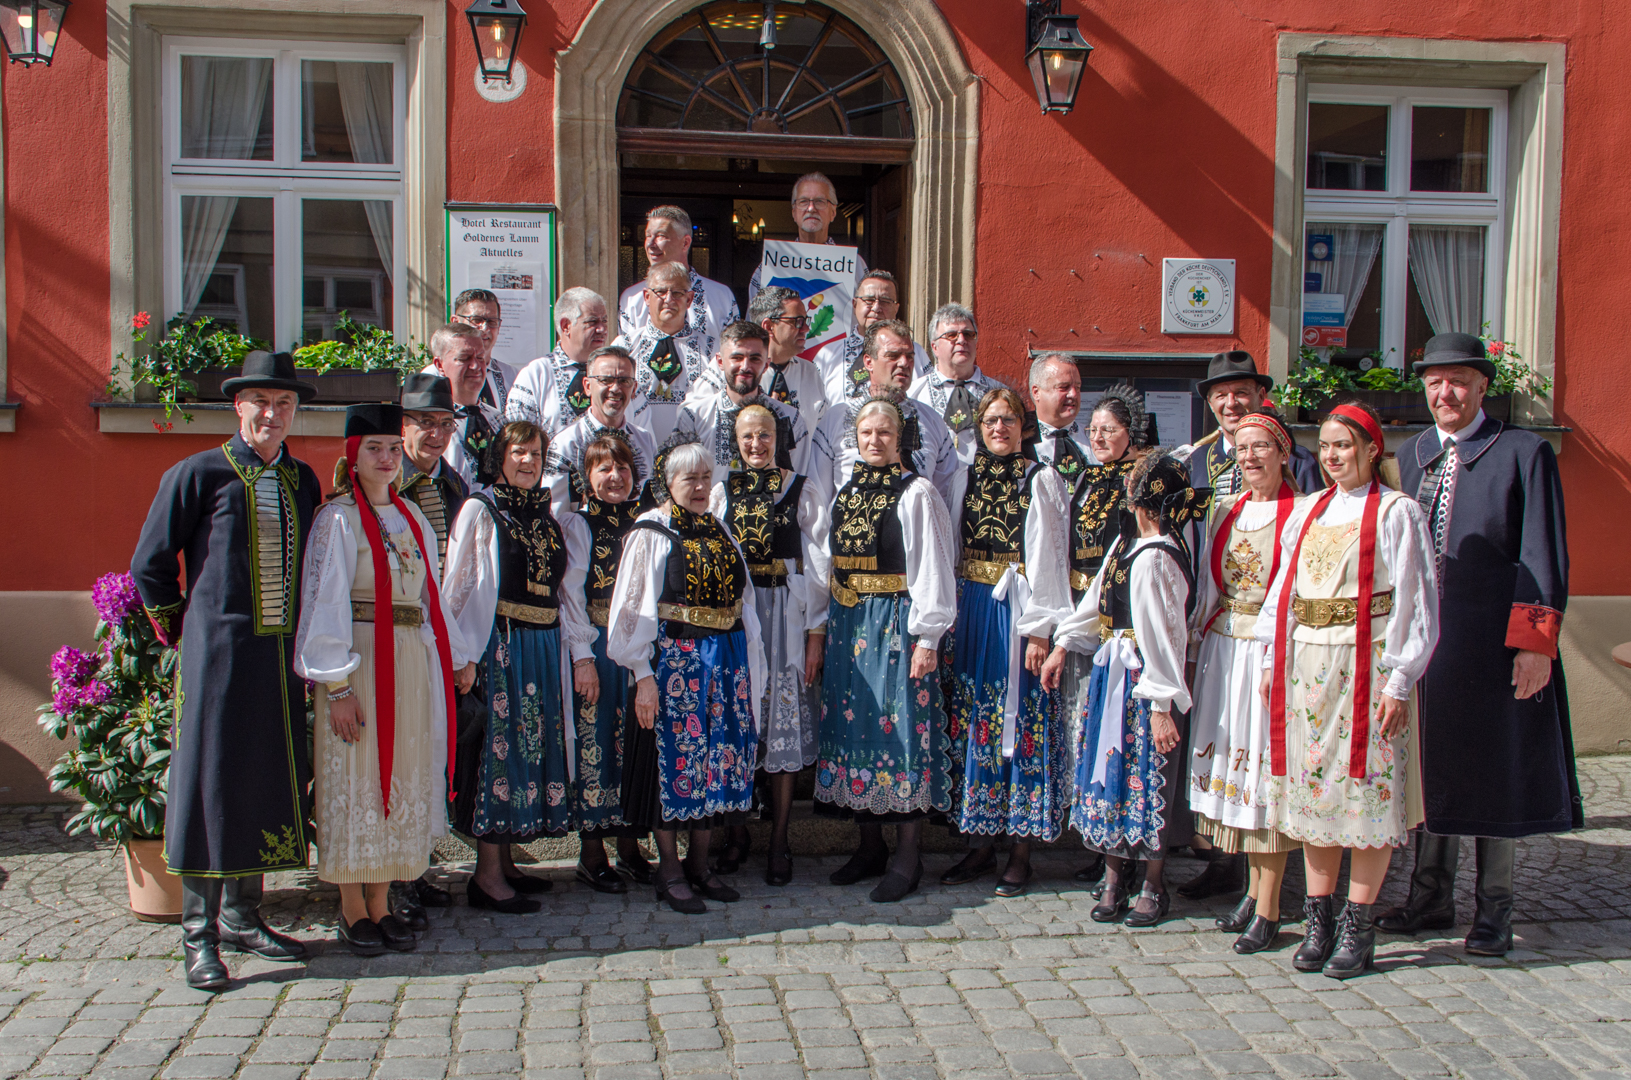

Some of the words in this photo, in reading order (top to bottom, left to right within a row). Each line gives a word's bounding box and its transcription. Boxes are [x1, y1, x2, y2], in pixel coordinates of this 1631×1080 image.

[461, 217, 485, 229] Hotel
[490, 218, 541, 228] Restaurant
[463, 232, 504, 242] Goldenes
[509, 233, 539, 242] Lamm
[480, 247, 523, 257] Aktuelles
[764, 250, 854, 273] Neustadt
[1168, 276, 1179, 297] VERBAND
[1177, 269, 1186, 277] DER
[1201, 264, 1228, 288] DEUTSCHLANDS
[1175, 312, 1199, 328] FRANKFURT
[1210, 313, 1222, 323] MAIN
